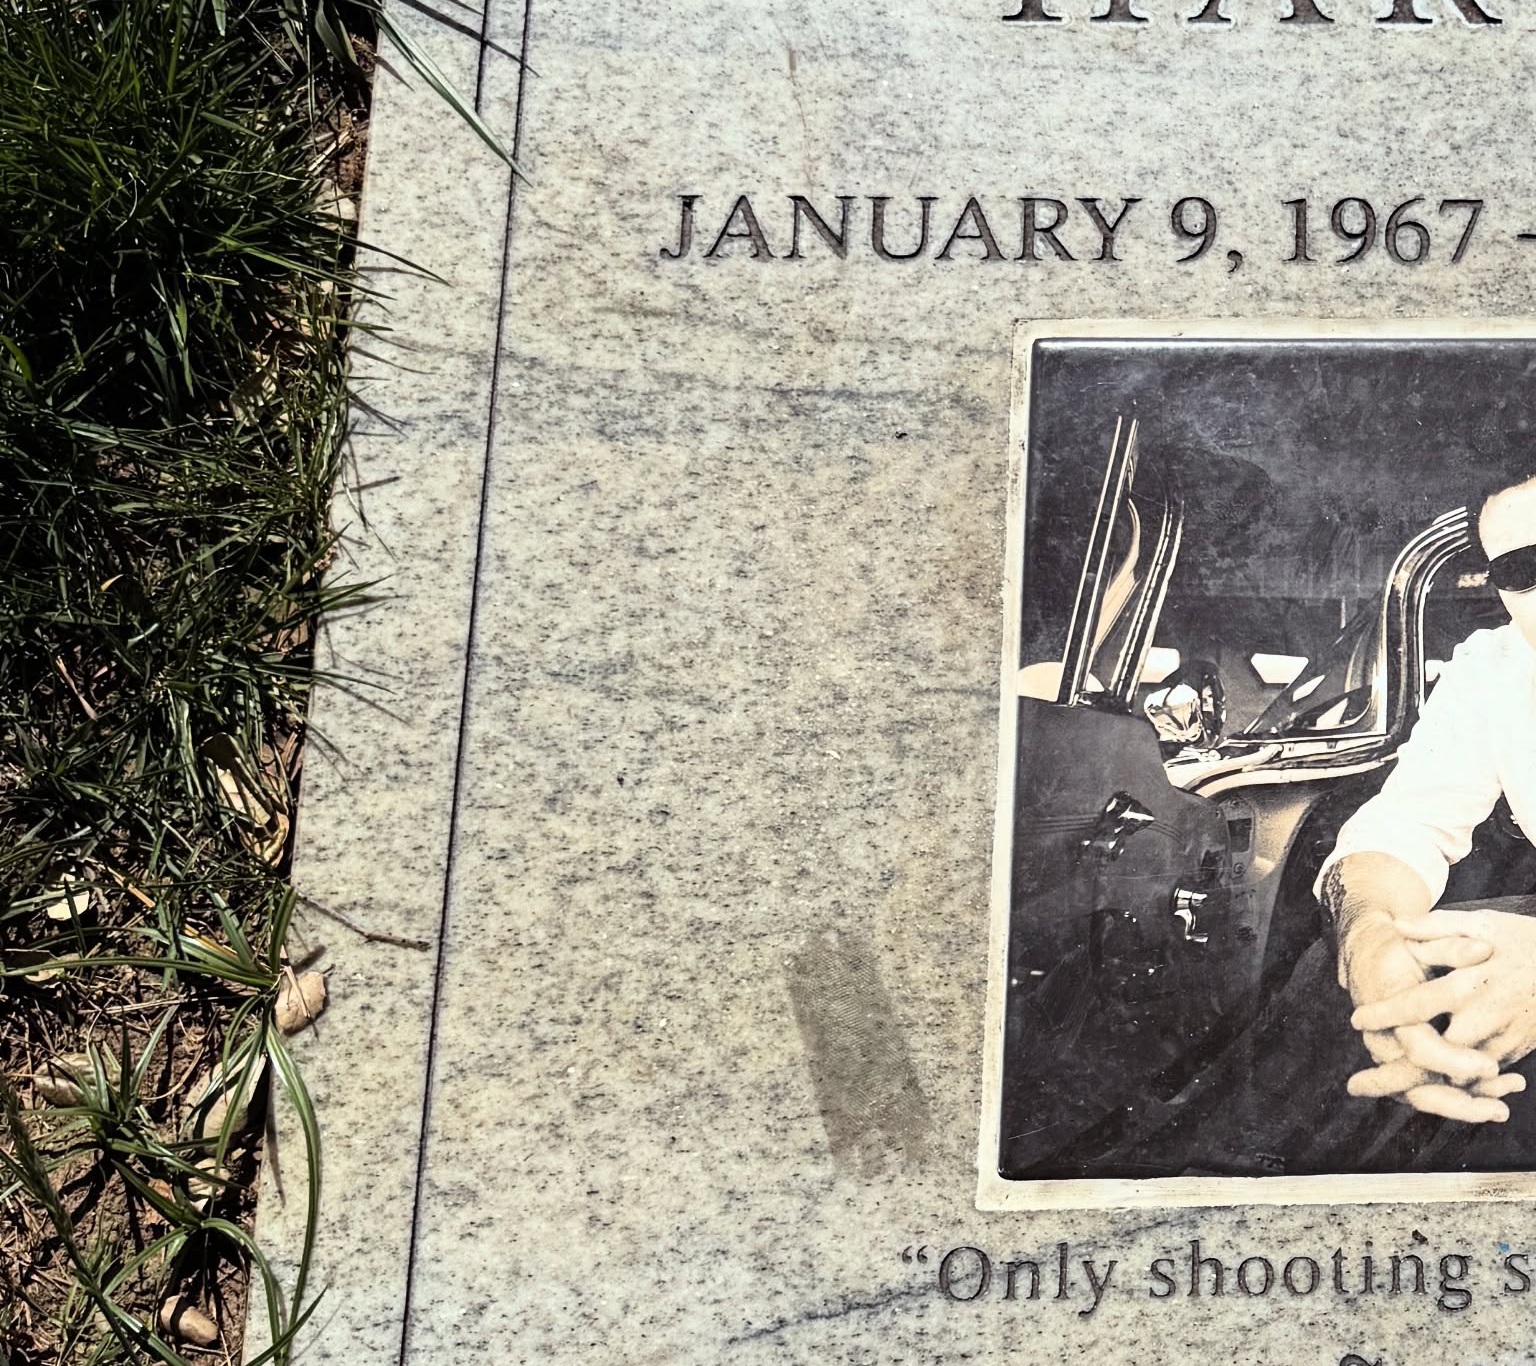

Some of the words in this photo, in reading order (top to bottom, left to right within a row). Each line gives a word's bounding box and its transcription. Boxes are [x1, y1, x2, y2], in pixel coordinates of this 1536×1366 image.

[659, 194, 1143, 263] JANUARY
[1171, 196, 1243, 276] 9,
[1282, 196, 1485, 264] 1967
[901, 1242, 1118, 1317] “Only
[1147, 1239, 1473, 1312] shooting
